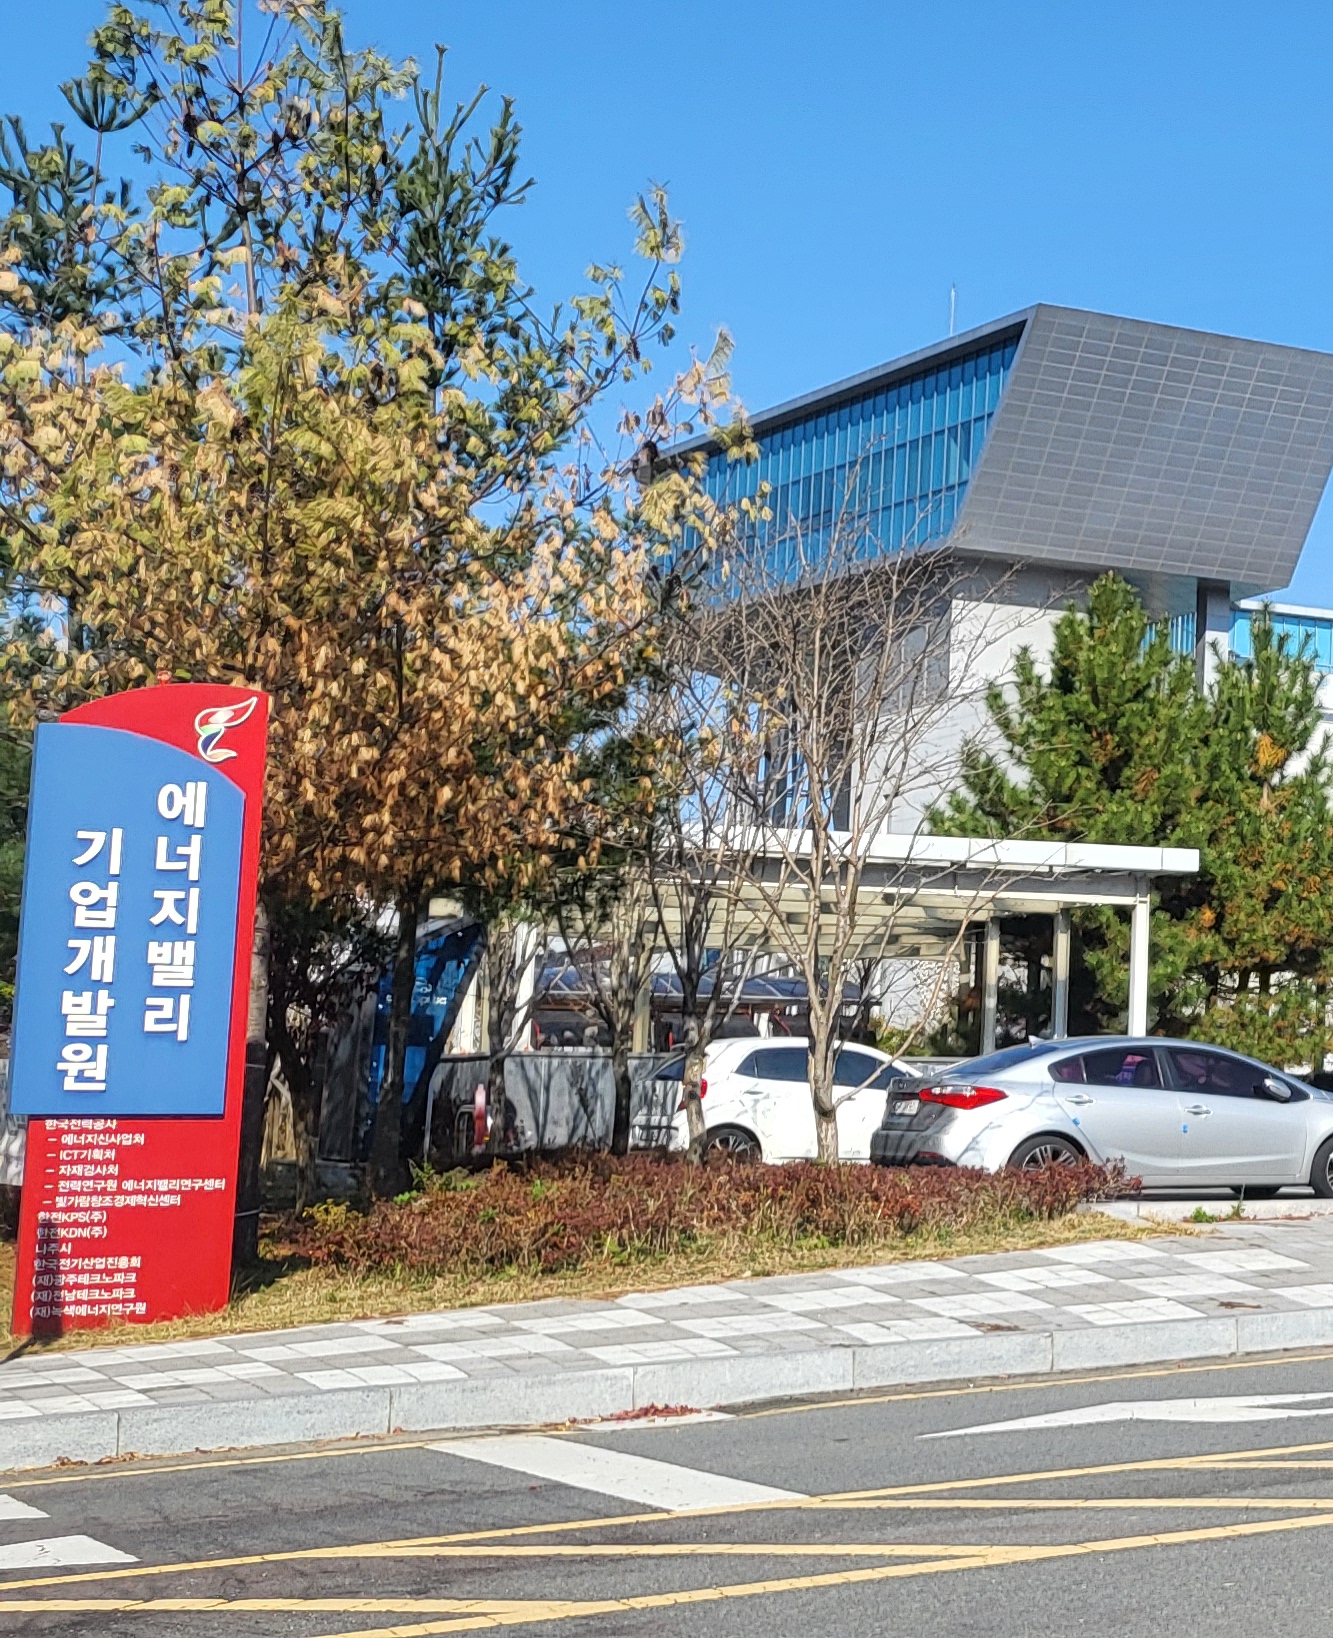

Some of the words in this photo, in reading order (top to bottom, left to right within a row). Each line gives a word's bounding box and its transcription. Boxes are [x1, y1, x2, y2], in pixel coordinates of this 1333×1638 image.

[143, 781, 208, 1042] 에너지밸리
[56, 827, 123, 1093] 기업개발원
[45, 1118, 117, 1130] 한국전력공사
[61, 1133, 145, 1146] 에너지신사업처
[59, 1148, 116, 1161] ICT기획처
[58, 1163, 119, 1176] 자재검사처
[57, 1179, 118, 1192] 전력연구원
[121, 1178, 226, 1192] 에너지밸리연구센터
[37, 1210, 107, 1224] 한전KPS(주)
[36, 1226, 108, 1239] 한전KDN(주)
[34, 1256, 142, 1271] 한국전기산업진흥회
